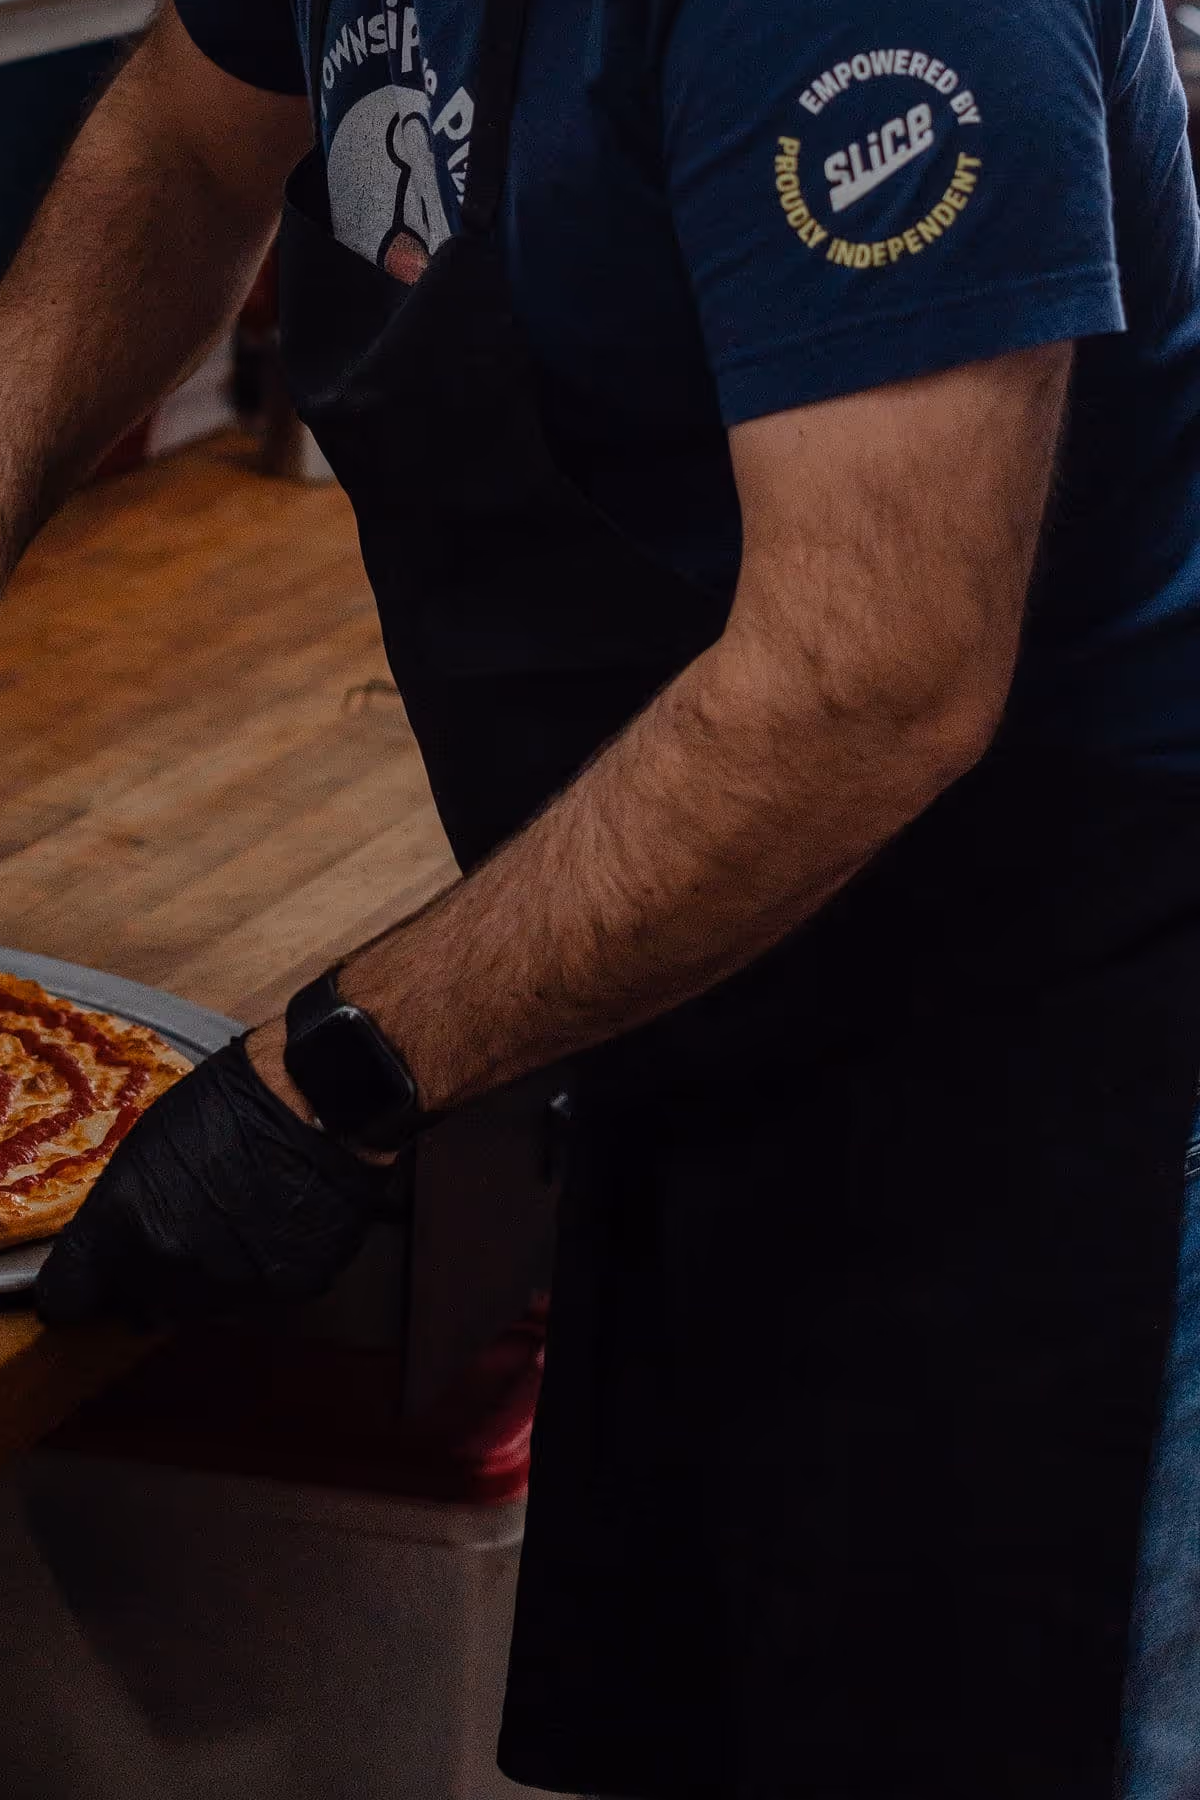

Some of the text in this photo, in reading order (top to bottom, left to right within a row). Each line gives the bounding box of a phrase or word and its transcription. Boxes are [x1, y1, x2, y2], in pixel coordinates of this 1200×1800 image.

[799, 49, 982, 125] EMPOWERED BY
[774, 135, 982, 270] PROUDLY INDEPENDENT
